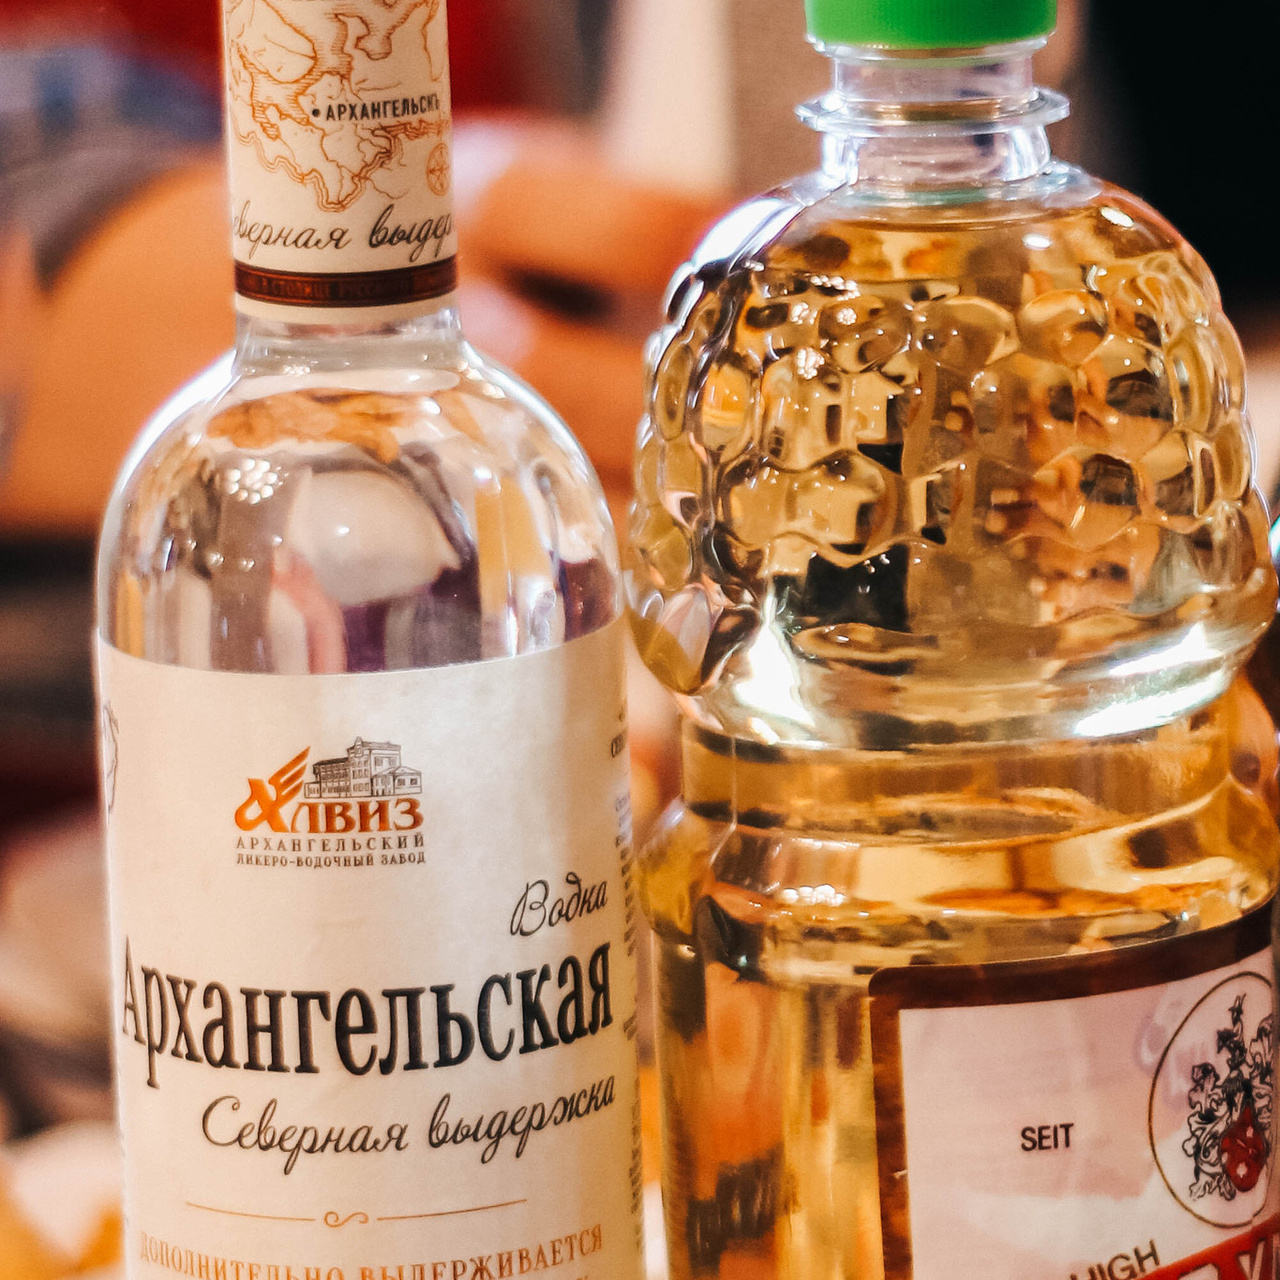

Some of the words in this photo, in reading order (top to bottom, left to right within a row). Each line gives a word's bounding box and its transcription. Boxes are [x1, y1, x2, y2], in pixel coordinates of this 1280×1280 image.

[236, 832, 425, 852] АРХАНГЕЛЬСКИЙ
[236, 852, 374, 870] ЛИКЕРО-ВОДОЧНЫЙ
[381, 851, 426, 866] ЗАВОД
[510, 871, 608, 937] Водка
[123, 935, 614, 1089] Архангельская
[202, 1094, 410, 1176] Северная
[427, 1075, 616, 1165] выдержка
[1020, 1122, 1074, 1152] SEIT
